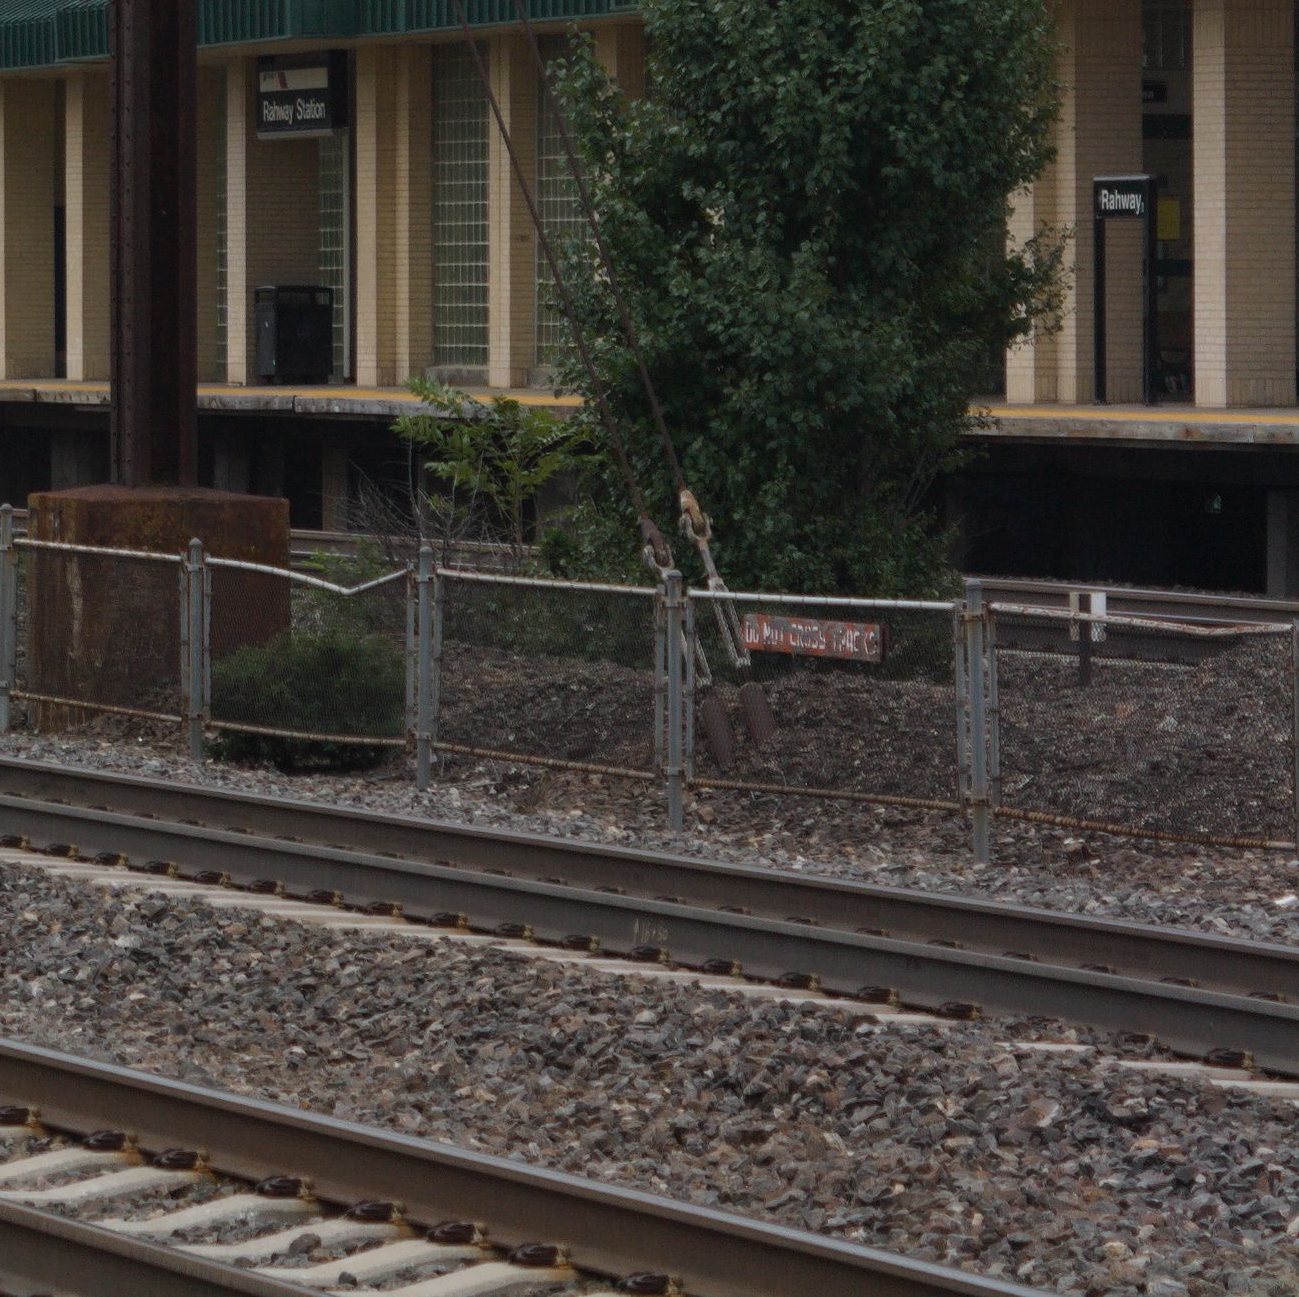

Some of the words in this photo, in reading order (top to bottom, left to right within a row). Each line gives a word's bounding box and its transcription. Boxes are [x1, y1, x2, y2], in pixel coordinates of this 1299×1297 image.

[263, 100, 294, 125] Rahway
[296, 97, 326, 120] Station
[1101, 189, 1142, 215] Rahway
